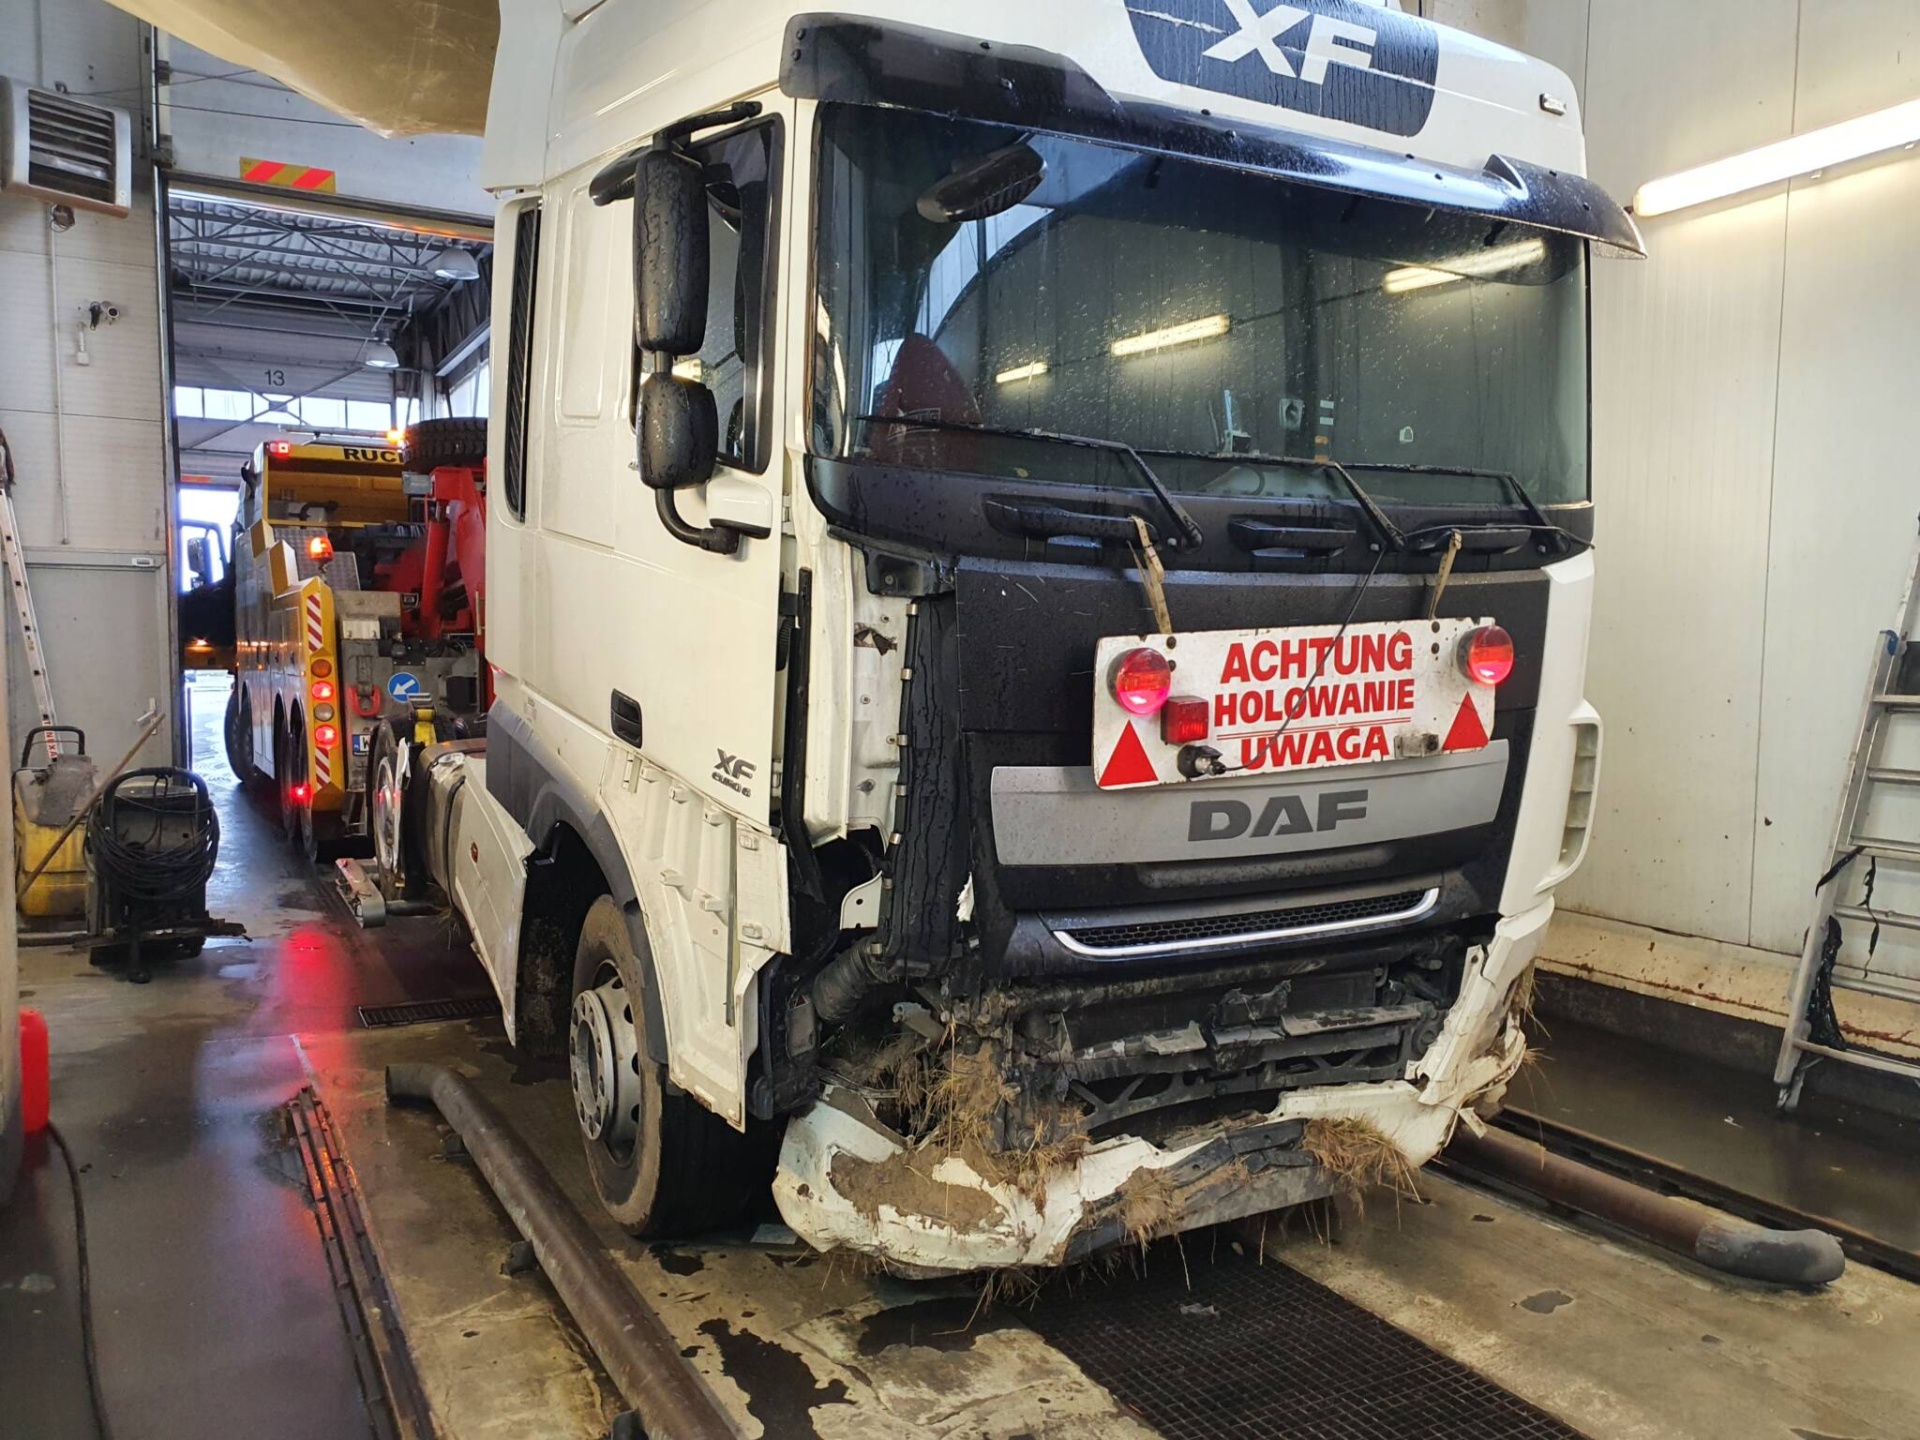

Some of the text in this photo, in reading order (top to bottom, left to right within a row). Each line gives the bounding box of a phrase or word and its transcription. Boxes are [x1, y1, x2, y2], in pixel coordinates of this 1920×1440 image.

[1202, 0, 1377, 86] XF
[264, 369, 285, 386] 13
[343, 448, 402, 464] RUC
[1219, 631, 1413, 684] ACHTUNG
[1213, 679, 1415, 727] HOLOWANIE
[714, 747, 757, 780] XF
[1240, 726, 1390, 770] UWAGA
[1188, 789, 1369, 842] DAF
